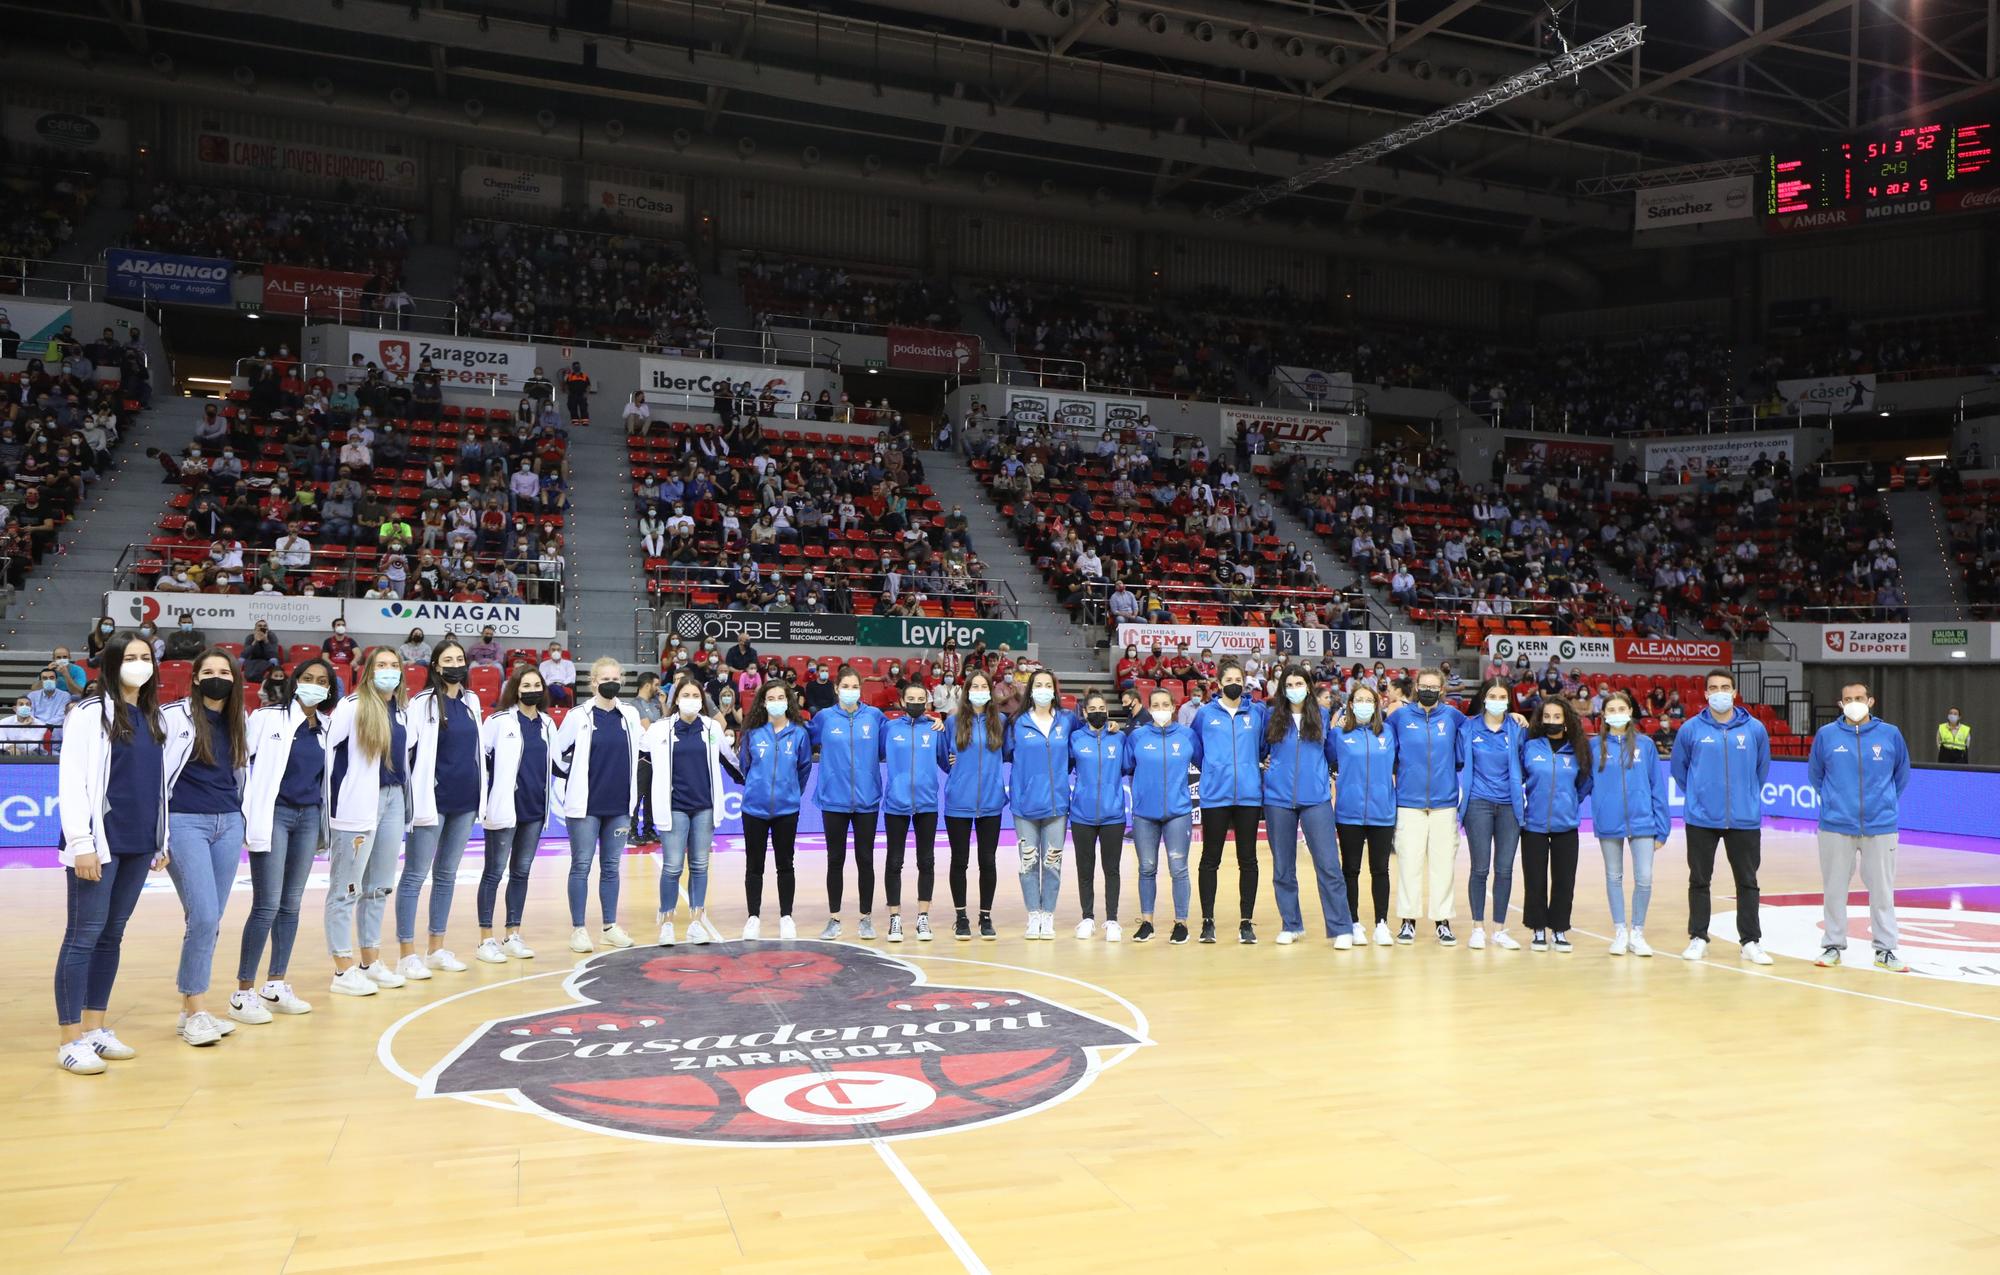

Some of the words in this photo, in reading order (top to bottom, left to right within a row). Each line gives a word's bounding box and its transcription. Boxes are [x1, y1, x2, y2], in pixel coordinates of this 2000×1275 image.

[617, 193, 673, 214] EnCasa
[1648, 202, 1713, 219] Sánchez
[1866, 201, 1931, 218] MONDO
[1794, 210, 1847, 229] AMBAR
[117, 258, 228, 281] ARABINGO
[420, 343, 508, 367] Zaragoza
[893, 341, 953, 359] podoactiva
[439, 368, 508, 386] EPORTE
[167, 604, 235, 618] Inycom
[249, 600, 310, 612] innovation
[415, 604, 520, 621] ANAGAN
[249, 612, 321, 624] technologies
[789, 619, 815, 627] ENERGÍA
[704, 620, 782, 640] ORBE
[789, 634, 855, 642] TELECOMUNICACIONES
[1849, 630, 1908, 643] Zaragoza
[1221, 637, 1265, 648] VOLUM
[1517, 641, 1548, 651] KERN
[1580, 643, 1610, 652] KERN
[1627, 642, 1721, 657] ALEJANDRO
[1849, 642, 1907, 653] DEPORTE
[499, 1010, 1052, 1064] Casademont
[672, 1040, 946, 1071] ZARAGOZA
